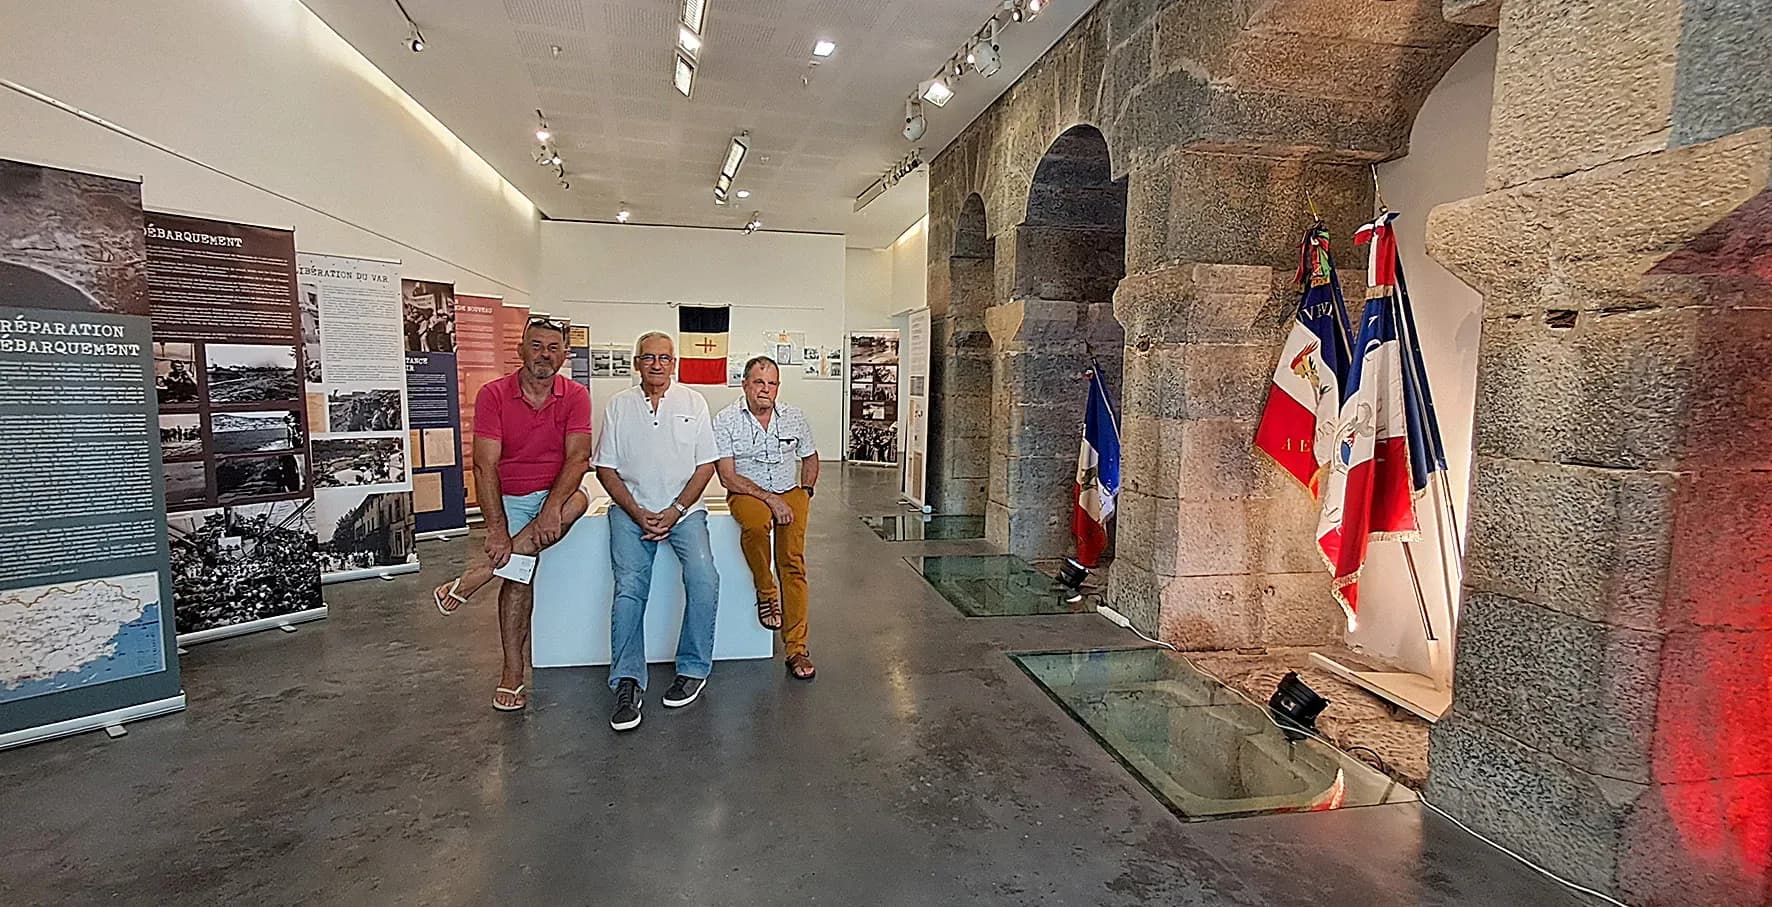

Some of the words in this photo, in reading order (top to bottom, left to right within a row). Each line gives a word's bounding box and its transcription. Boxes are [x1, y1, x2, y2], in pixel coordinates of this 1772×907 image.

[296, 265, 352, 279] IBÉRATION
[356, 272, 368, 281] DU
[371, 274, 390, 283] VAR
[0, 314, 125, 338] RÉPARATION
[0, 333, 140, 356] ÉBARQUEMENT
